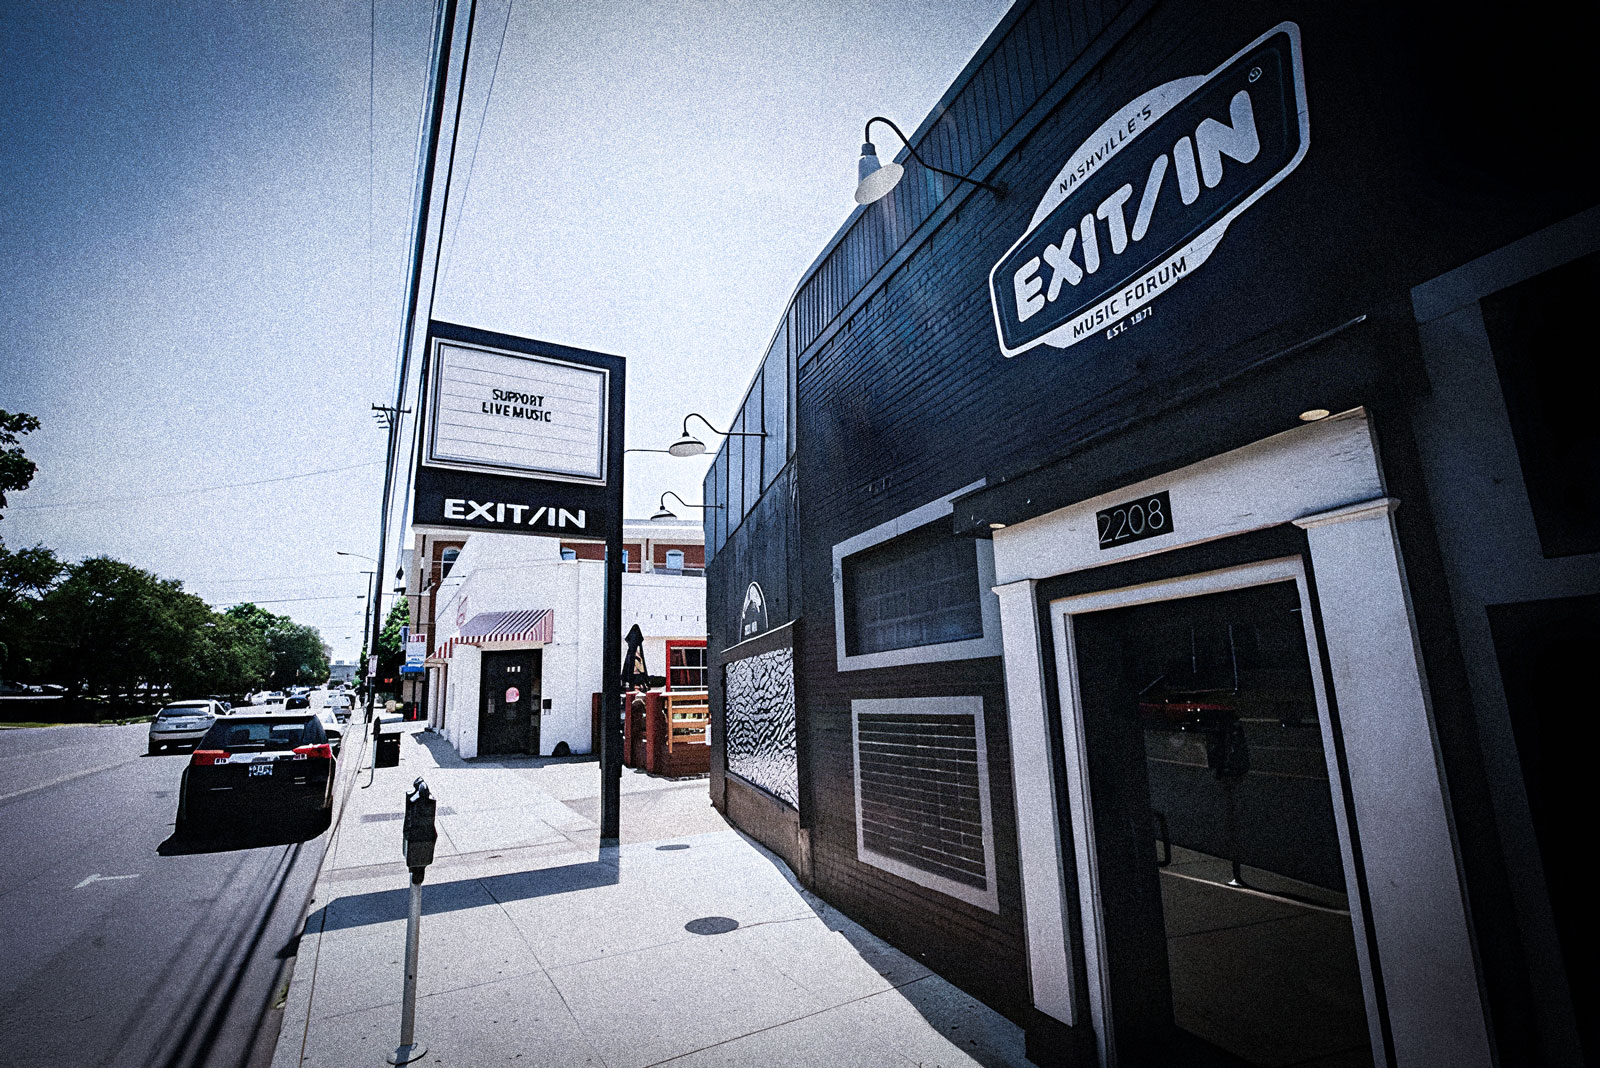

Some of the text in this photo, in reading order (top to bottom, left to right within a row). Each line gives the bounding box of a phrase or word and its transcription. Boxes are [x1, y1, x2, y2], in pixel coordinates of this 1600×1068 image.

[1058, 104, 1153, 195] NASHVILLE'S
[1013, 90, 1261, 323] EXIT/IN
[1073, 256, 1187, 339] MUSIC FORUM
[482, 401, 552, 423] LIVE MUSIC
[492, 389, 545, 407] SUPPORT
[443, 498, 586, 529] EXIT/IN
[1097, 498, 1164, 544] 2208
